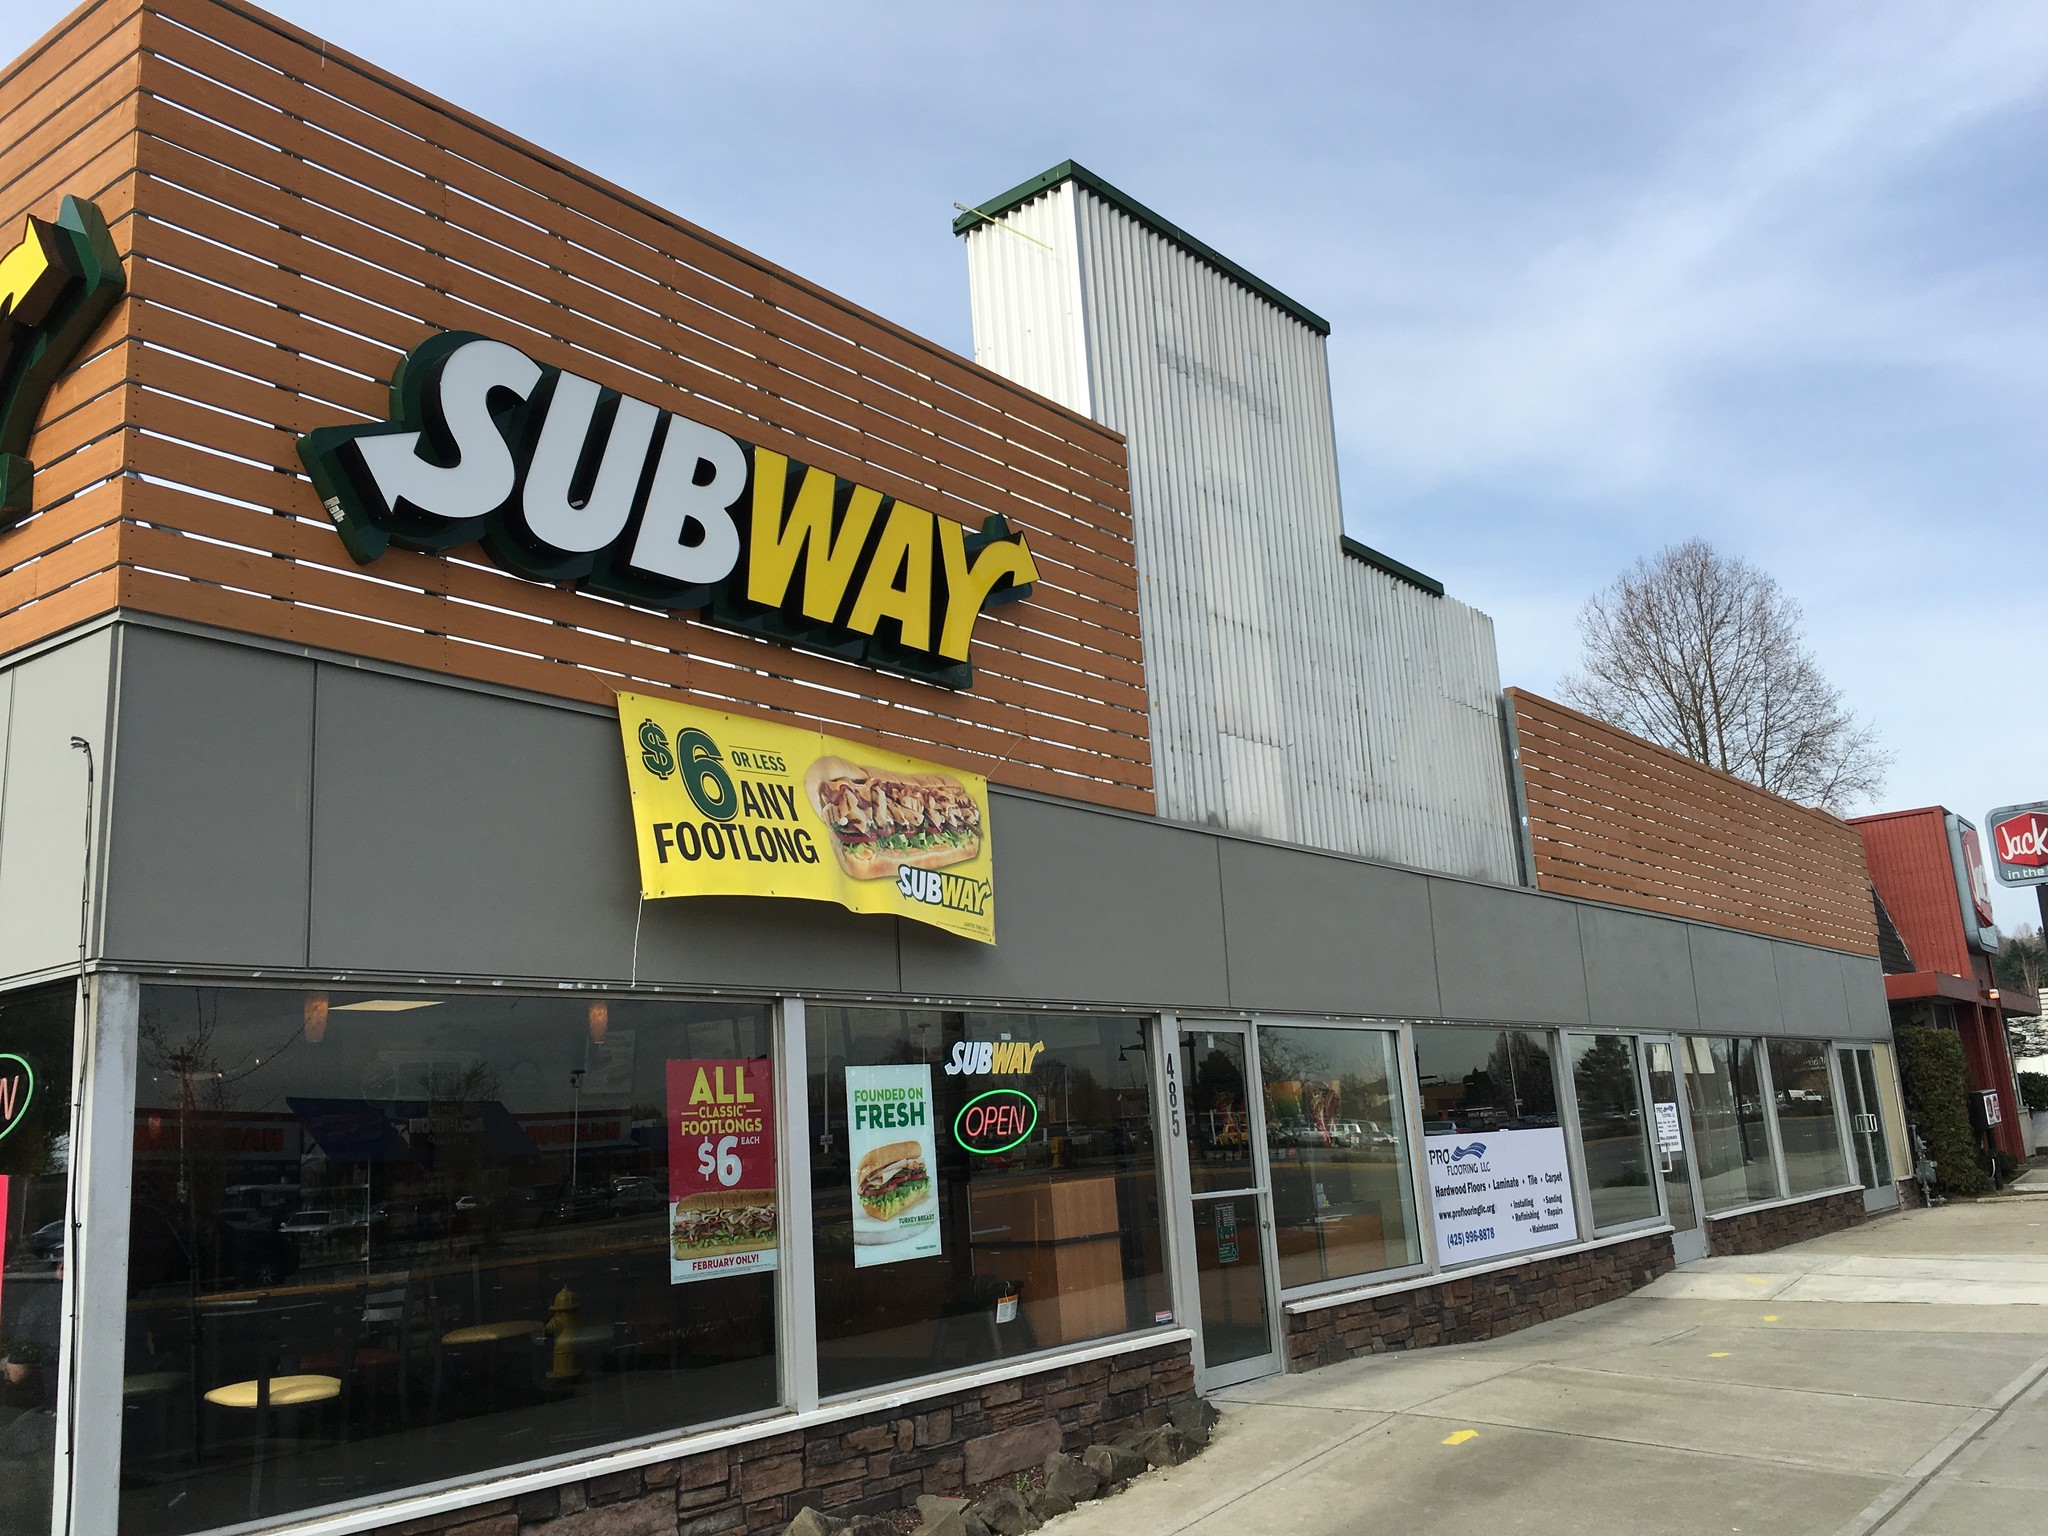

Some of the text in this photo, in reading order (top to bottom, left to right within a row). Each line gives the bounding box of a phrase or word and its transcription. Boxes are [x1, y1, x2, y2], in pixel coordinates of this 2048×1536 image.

[354, 339, 1041, 663] SUBWAY
[638, 718, 739, 822] $6
[731, 750, 787, 772] OR LESS
[740, 780, 799, 822] ANY
[652, 821, 820, 864] FOOTLONG
[2001, 818, 2048, 860] Jack
[2008, 869, 2020, 880] in
[2022, 867, 2045, 878] the
[896, 864, 992, 916] SUBWAY
[944, 1040, 1045, 1075] SUBWAY
[688, 1066, 755, 1104] ALL
[854, 1087, 924, 1102] FOUNDED ON
[681, 1118, 763, 1136] FOOTLONGS
[855, 1102, 925, 1130] FRESH
[965, 1105, 1026, 1136] OPEN
[698, 1135, 760, 1187] $6 EACH
[1428, 1149, 1450, 1165] PRO
[1446, 1161, 1491, 1176] FLOORING LLC
[1434, 1171, 1563, 1198] Hardwood Floors Laminate Tile Carpet
[898, 1213, 936, 1225] TURKEY BREAST
[1447, 1232, 1466, 1249] (425)
[692, 1254, 760, 1271] FEBRUARY ONLY!
